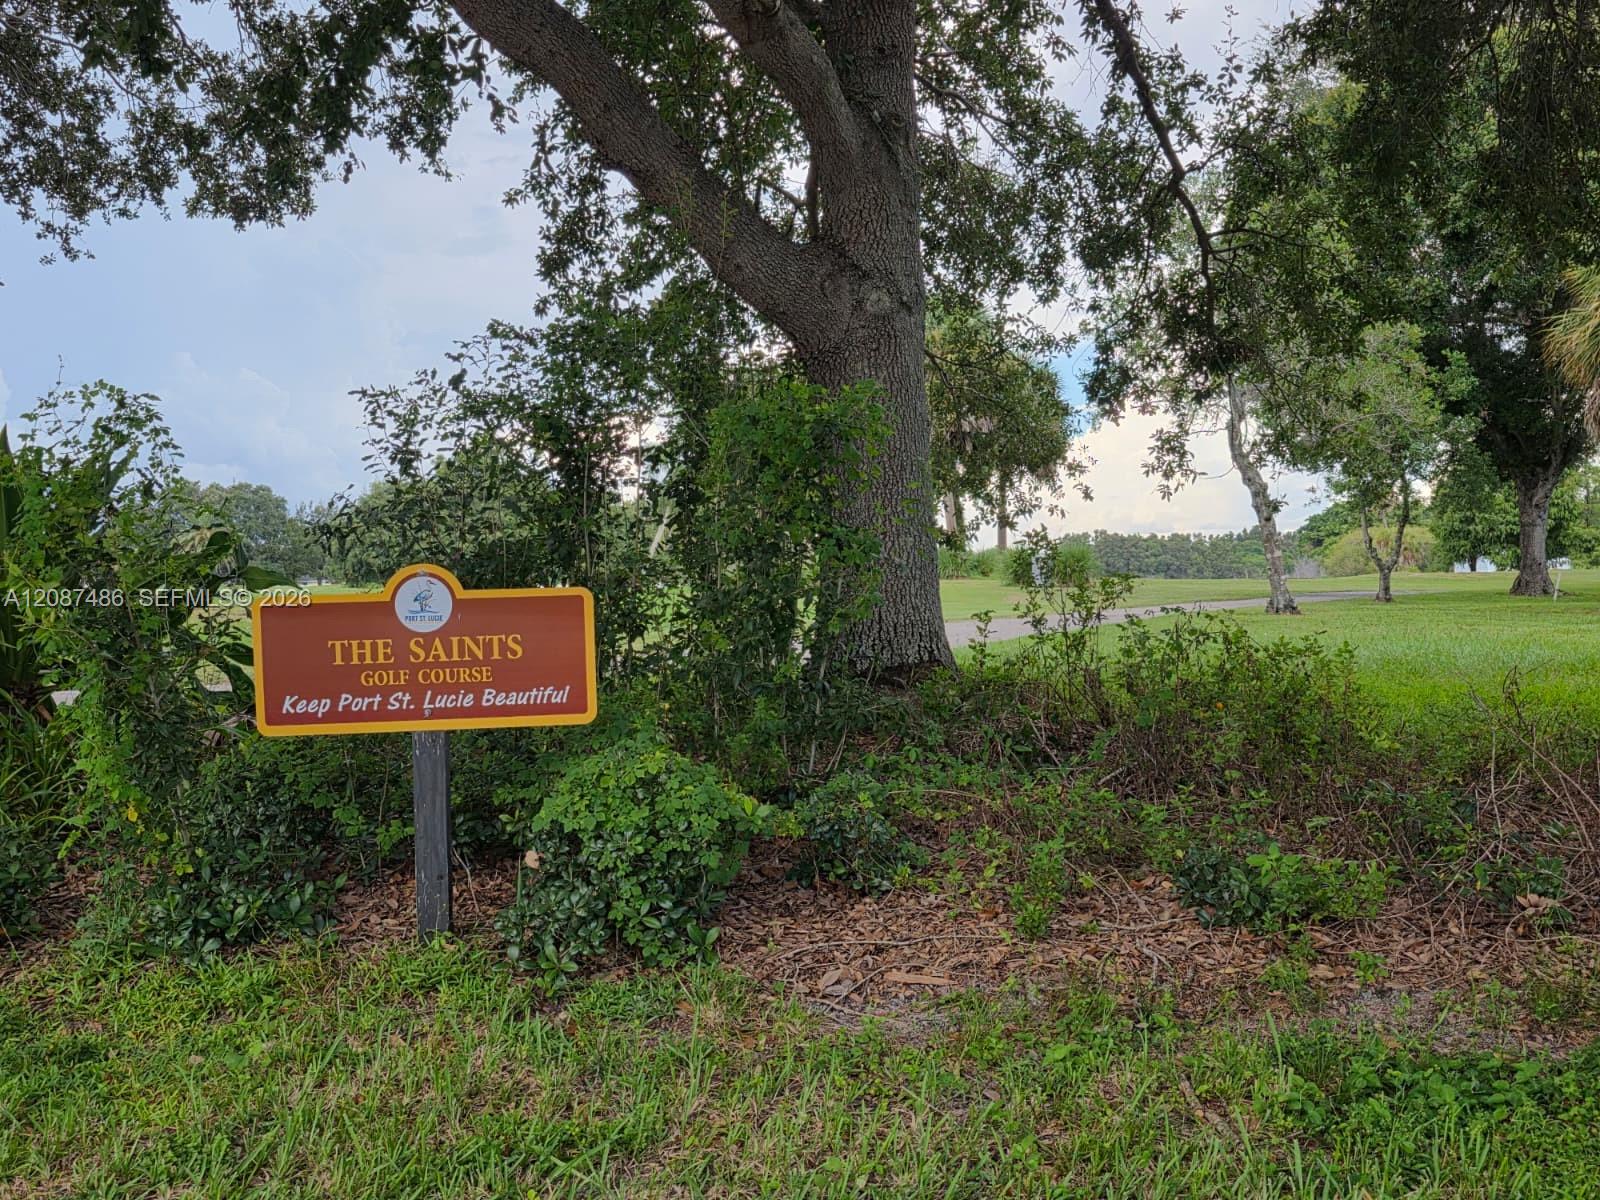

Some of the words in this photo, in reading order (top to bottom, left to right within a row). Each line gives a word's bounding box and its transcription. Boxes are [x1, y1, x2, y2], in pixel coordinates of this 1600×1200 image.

[328, 638, 395, 665] THE
[409, 634, 524, 664] SAINTS
[360, 670, 410, 687] GOLF
[417, 666, 493, 685] COURSE
[282, 695, 331, 718] Keep
[338, 693, 381, 712] Port
[387, 691, 415, 710] St.
[423, 687, 474, 709] Lucie
[481, 685, 570, 707] Beautiful
